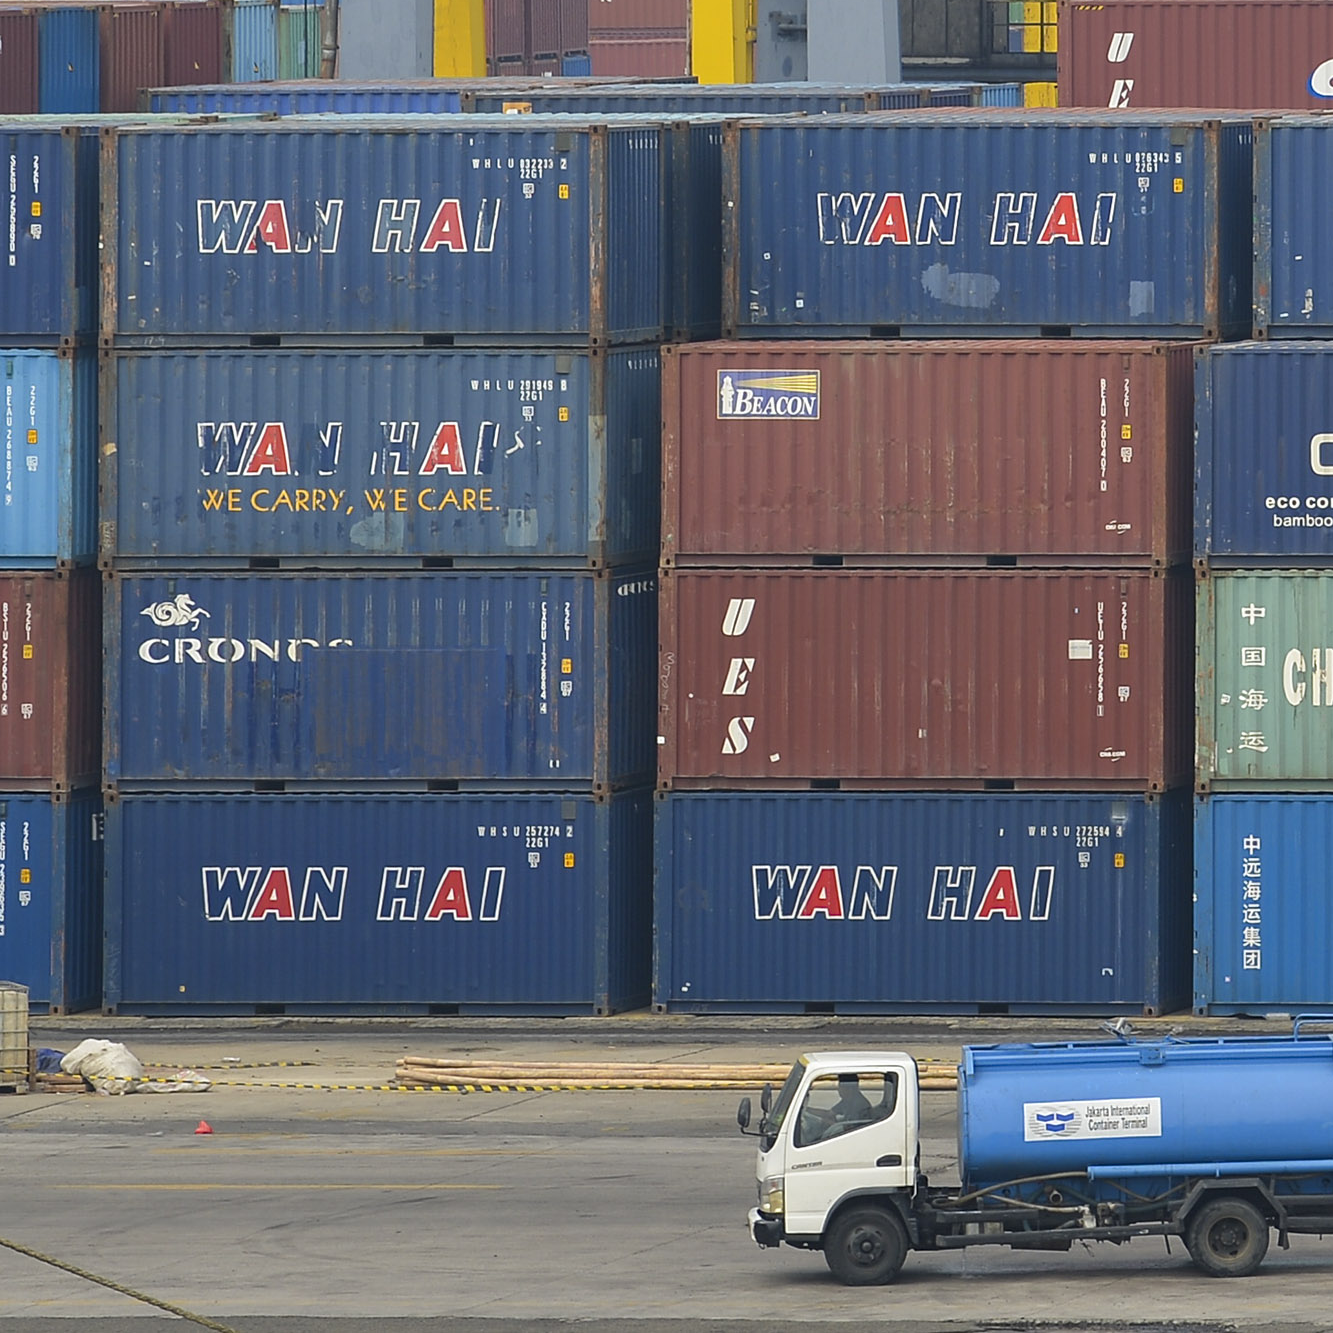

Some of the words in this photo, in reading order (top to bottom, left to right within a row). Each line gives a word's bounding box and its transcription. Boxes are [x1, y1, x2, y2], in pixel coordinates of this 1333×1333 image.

[198, 200, 343, 253] WAN
[372, 199, 500, 252] HAI
[818, 193, 961, 245] WAN
[990, 193, 1116, 245] HAI
[197, 486, 242, 511] WE
[364, 488, 411, 515] WE
[1266, 497, 1300, 508] eco
[1274, 514, 1333, 526] bamboo
[1239, 604, 1268, 752] 中国海运
[202, 867, 348, 920] WAN
[377, 867, 505, 920] HAI
[753, 866, 897, 919] WAN
[927, 867, 1054, 920] HAI
[1243, 835, 1260, 969] 中远海运集团
[1086, 1106, 1109, 1119] Jakarta
[1110, 1104, 1150, 1116] International
[1089, 1119, 1119, 1131] Container
[1121, 1117, 1147, 1129] Terminal
